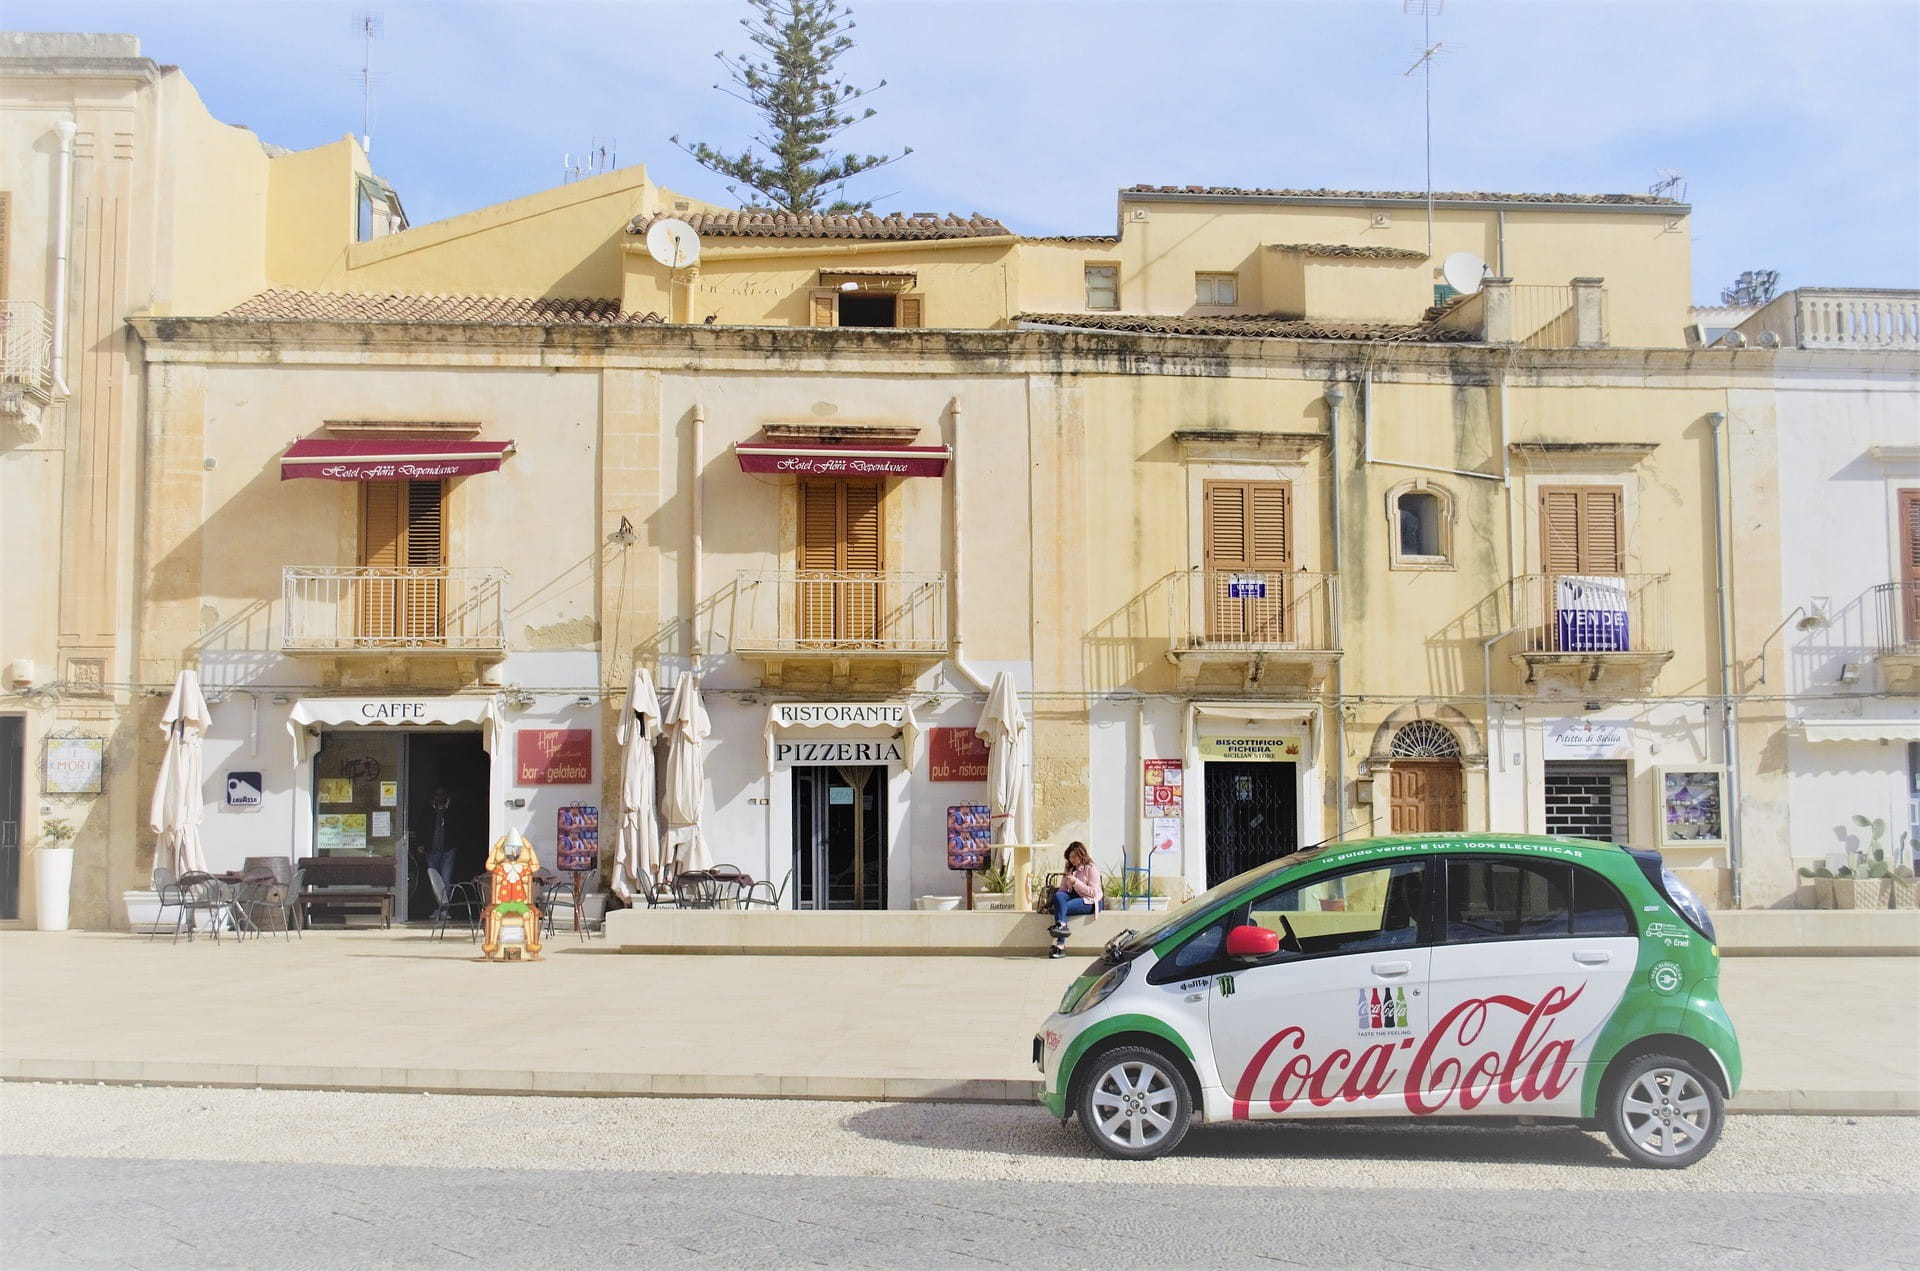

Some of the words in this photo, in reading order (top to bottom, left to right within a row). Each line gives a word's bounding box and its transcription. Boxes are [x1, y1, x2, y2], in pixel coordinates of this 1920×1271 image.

[778, 457, 813, 470] Hotel
[322, 465, 361, 478] Hotel
[1562, 611, 1625, 626] VENDE
[781, 706, 903, 721] RISTORANTE
[776, 743, 902, 761] PIZZERIA
[523, 763, 539, 779] bar
[547, 763, 587, 783] gelateria
[932, 761, 950, 781] pub
[1338, 849, 1372, 861] guido
[1376, 844, 1416, 853] verde.
[1499, 843, 1583, 858] ELECTRICAR
[1673, 938, 1688, 947] Enel
